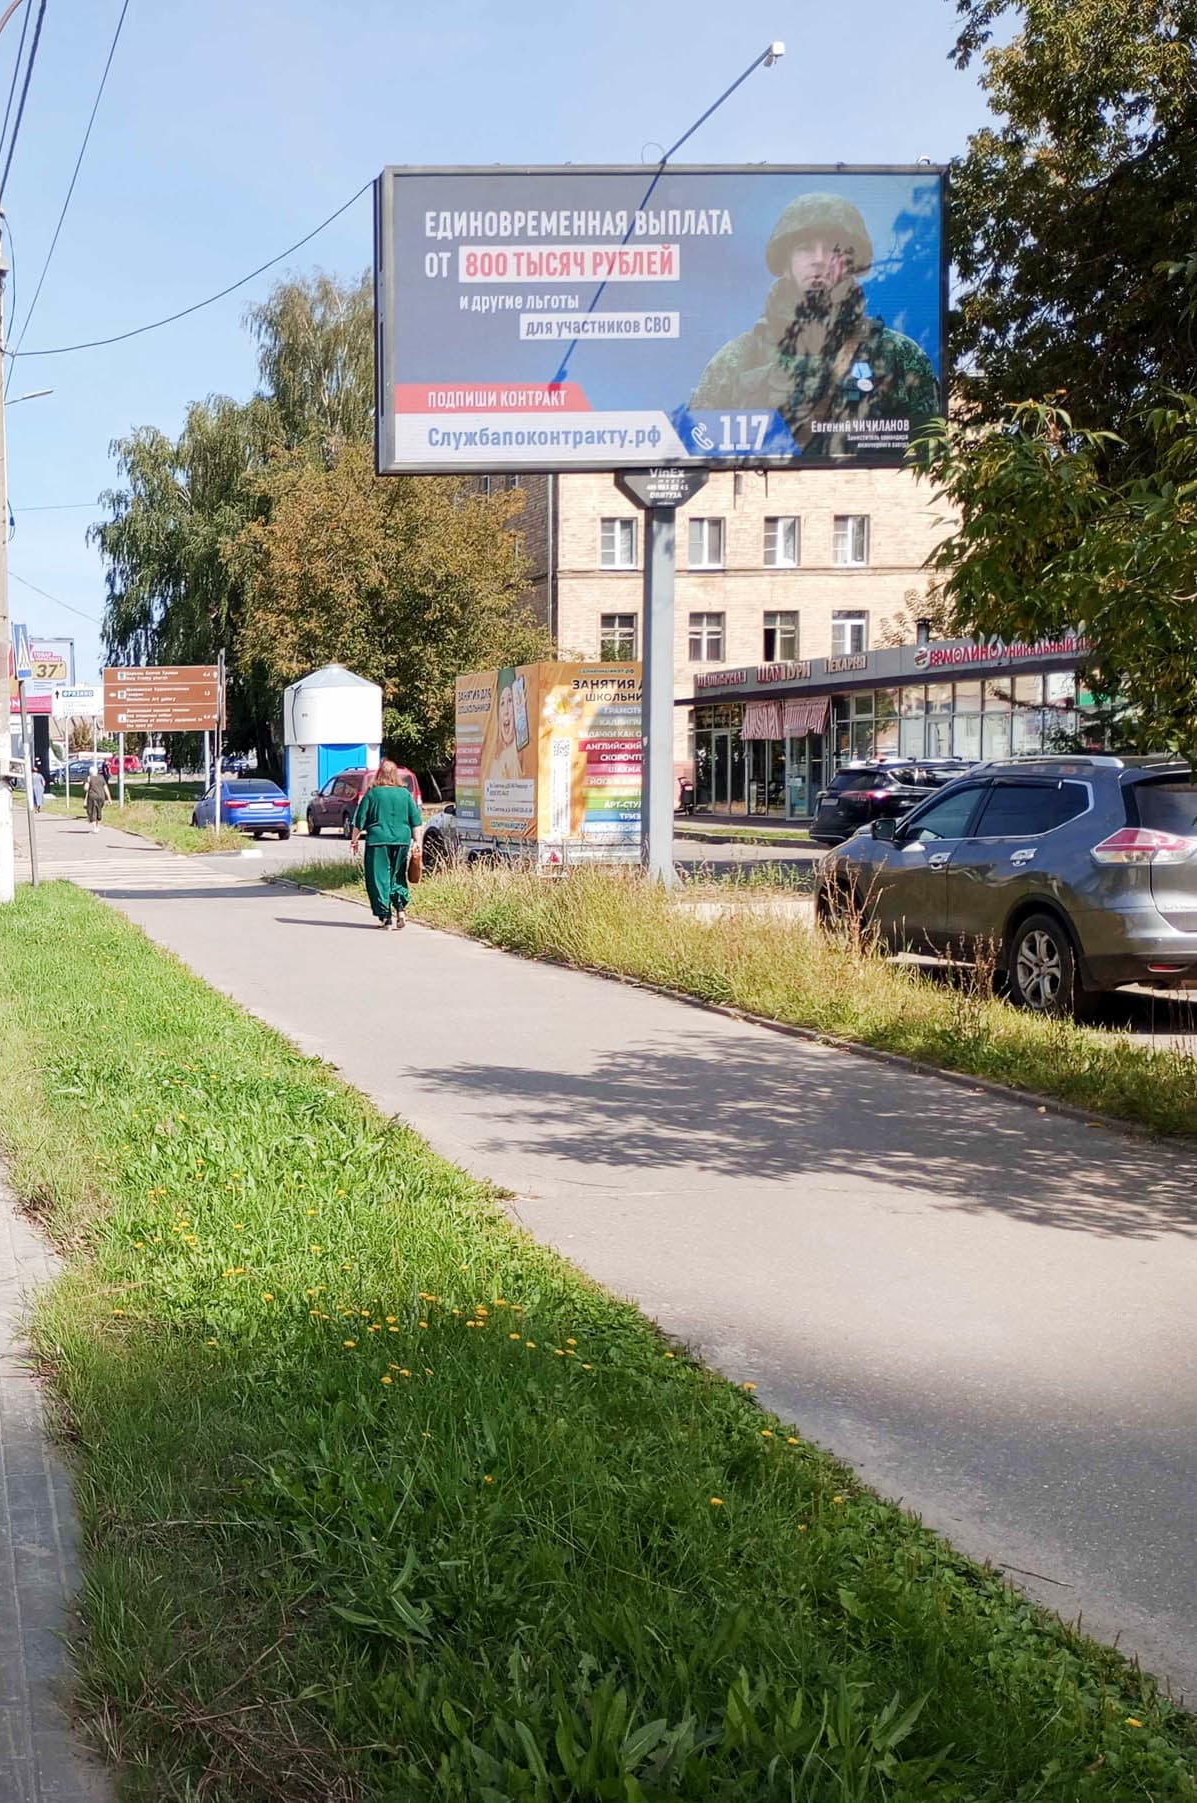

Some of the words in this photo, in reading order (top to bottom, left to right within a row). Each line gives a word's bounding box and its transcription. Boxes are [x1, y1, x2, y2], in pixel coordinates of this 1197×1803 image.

[425, 210, 627, 240] ЕДИНОВРЕМЕННАЯ
[635, 209, 733, 236] ВЫПЛАТА
[425, 252, 451, 278] ОТ
[465, 252, 508, 278] 800
[513, 251, 585, 277] ТЫСЯЧ
[592, 246, 674, 277] РУБЛЕЙ
[460, 296, 468, 309] и
[472, 295, 522, 313] другие
[526, 294, 579, 310] льготы
[526, 322, 552, 337] для
[557, 317, 640, 337] участников
[644, 316, 671, 334] СВО
[427, 391, 497, 409] ПОДПИШИ
[501, 389, 567, 407] КОНТРАКТ
[428, 425, 661, 451] Службапоконтракту.рф
[719, 414, 769, 451] 117
[811, 420, 851, 433] Евгений
[853, 419, 910, 432] ЧИЧИЛАНОВ
[930, 644, 1001, 666] ЕРМОЛИНО
[572, 679, 635, 690] ЗАНЯТИЯ
